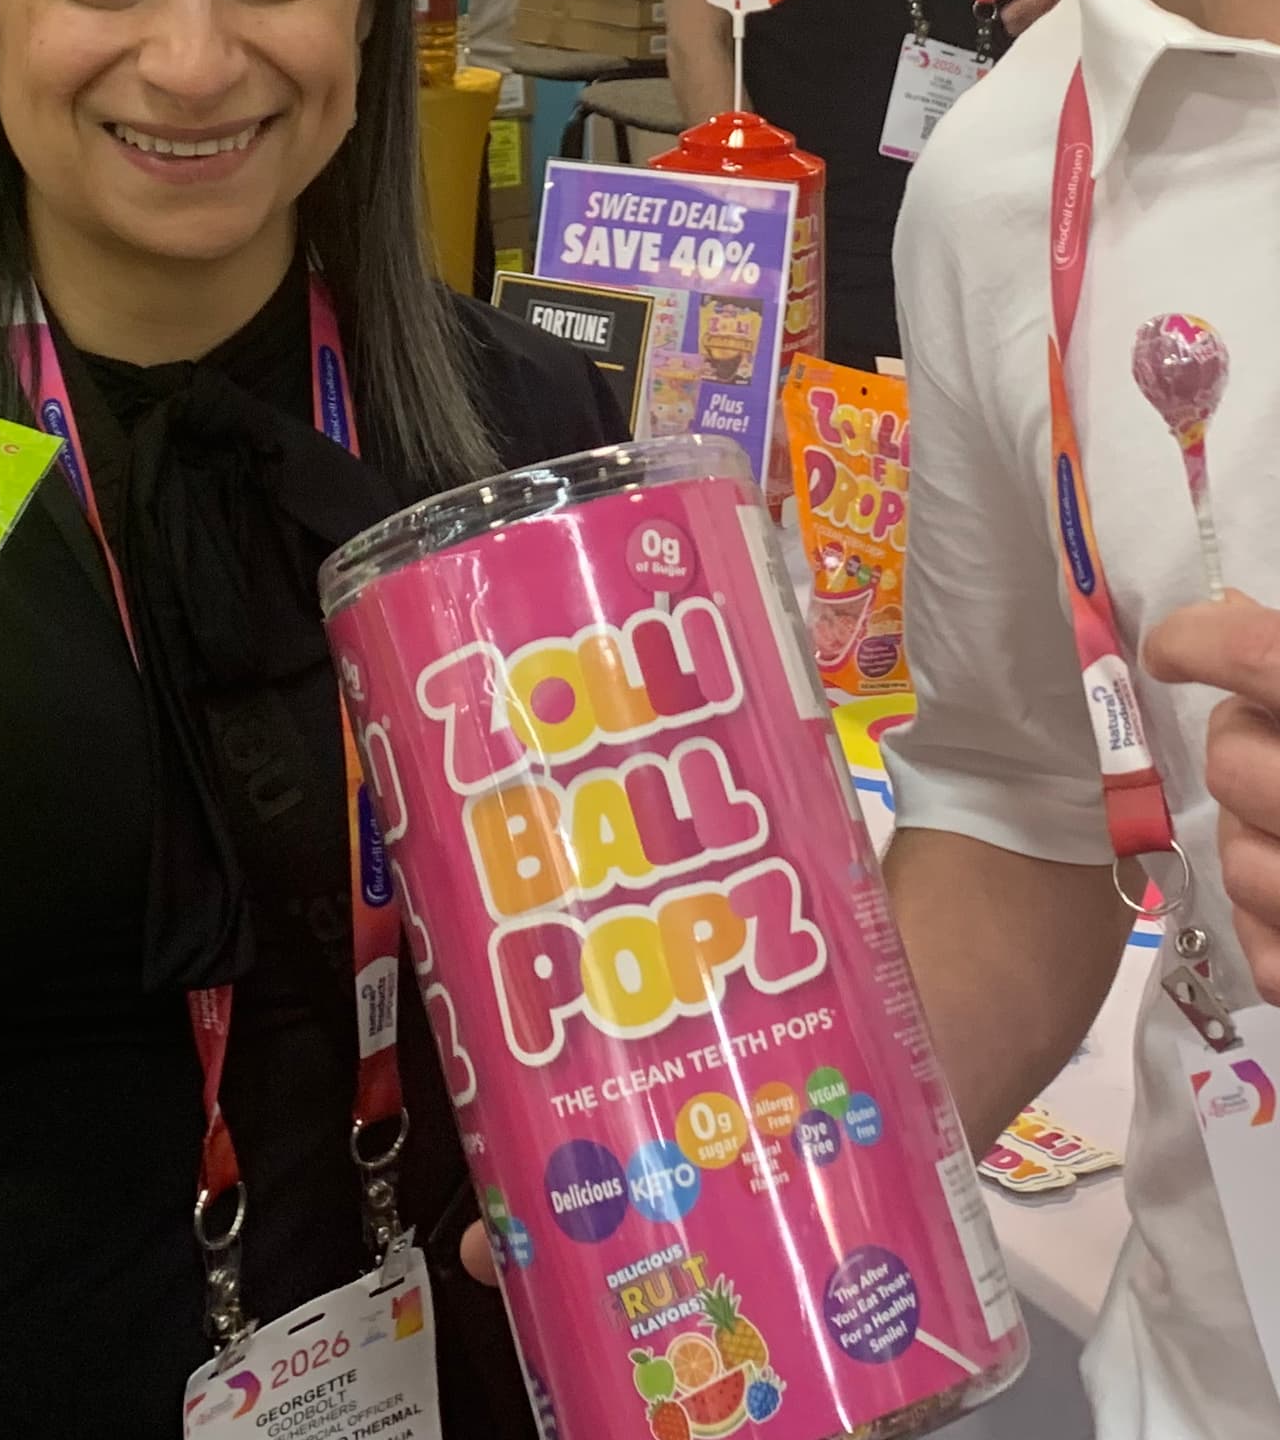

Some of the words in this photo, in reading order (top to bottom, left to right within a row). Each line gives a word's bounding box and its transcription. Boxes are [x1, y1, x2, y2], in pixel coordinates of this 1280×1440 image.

[586, 191, 667, 227] SWEET
[668, 199, 747, 234] DEALS
[560, 223, 661, 274] SAVE
[669, 237, 761, 285] 40%
[531, 305, 610, 345] FORTUNE
[701, 411, 750, 433] More!
[710, 393, 744, 416] Plus
[3, 442, 21, 455] C
[415, 595, 743, 797] ZOLLI
[1102, 693, 1122, 751] Natural
[462, 736, 769, 921] BALL
[487, 858, 826, 1067] POPZ
[550, 1086, 598, 1118] THE
[601, 1058, 686, 1105] CLEAN
[770, 1010, 833, 1051] POPS
[755, 1094, 795, 1118] Allergy
[808, 1082, 846, 1107] VEGAN
[767, 1113, 792, 1131] Free
[801, 1122, 828, 1143] Dye
[698, 1136, 740, 1162] sugar
[550, 1177, 623, 1215] Delicious
[630, 1163, 696, 1203] KETO
[606, 1244, 684, 1289] DELICIOUS
[833, 1283, 860, 1305] The
[859, 1263, 889, 1291] After
[831, 1307, 858, 1328] You
[858, 1295, 879, 1312] Eat
[876, 1275, 908, 1301] Treat
[840, 1329, 862, 1349] For
[864, 1322, 873, 1334] a
[871, 1293, 917, 1328] Healthy
[869, 1320, 908, 1354] Smile!
[271, 1330, 350, 1390] 2026
[256, 1369, 358, 1428] GEORGETTE
[267, 1389, 347, 1438] GODBOLT
[347, 1393, 405, 1427] OFFICER
[352, 1403, 424, 1440] THERMAL
